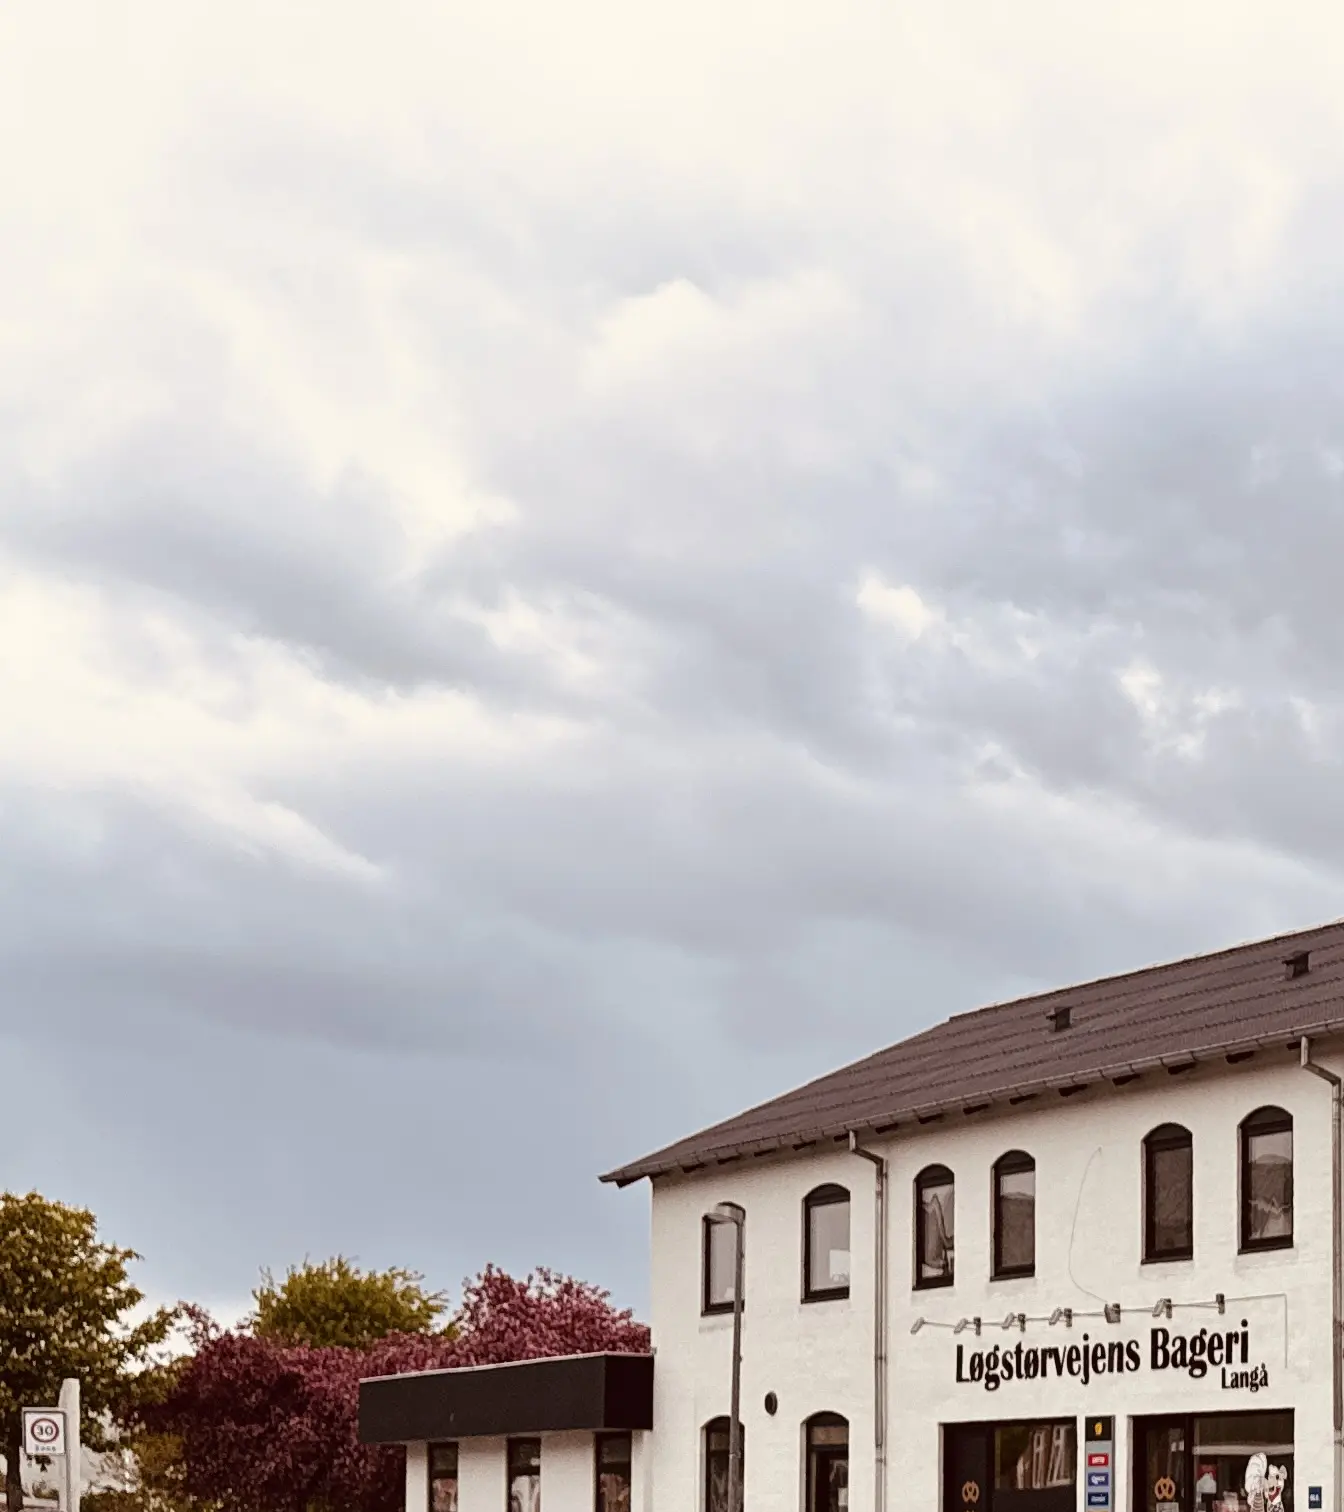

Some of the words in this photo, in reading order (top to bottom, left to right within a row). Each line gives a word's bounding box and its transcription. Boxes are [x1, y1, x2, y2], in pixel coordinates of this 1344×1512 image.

[956, 1333, 1141, 1391] Løgstørvejens
[1150, 1319, 1249, 1378] Bageri
[1221, 1363, 1269, 1392] Langå
[36, 1425, 54, 1436] 30
